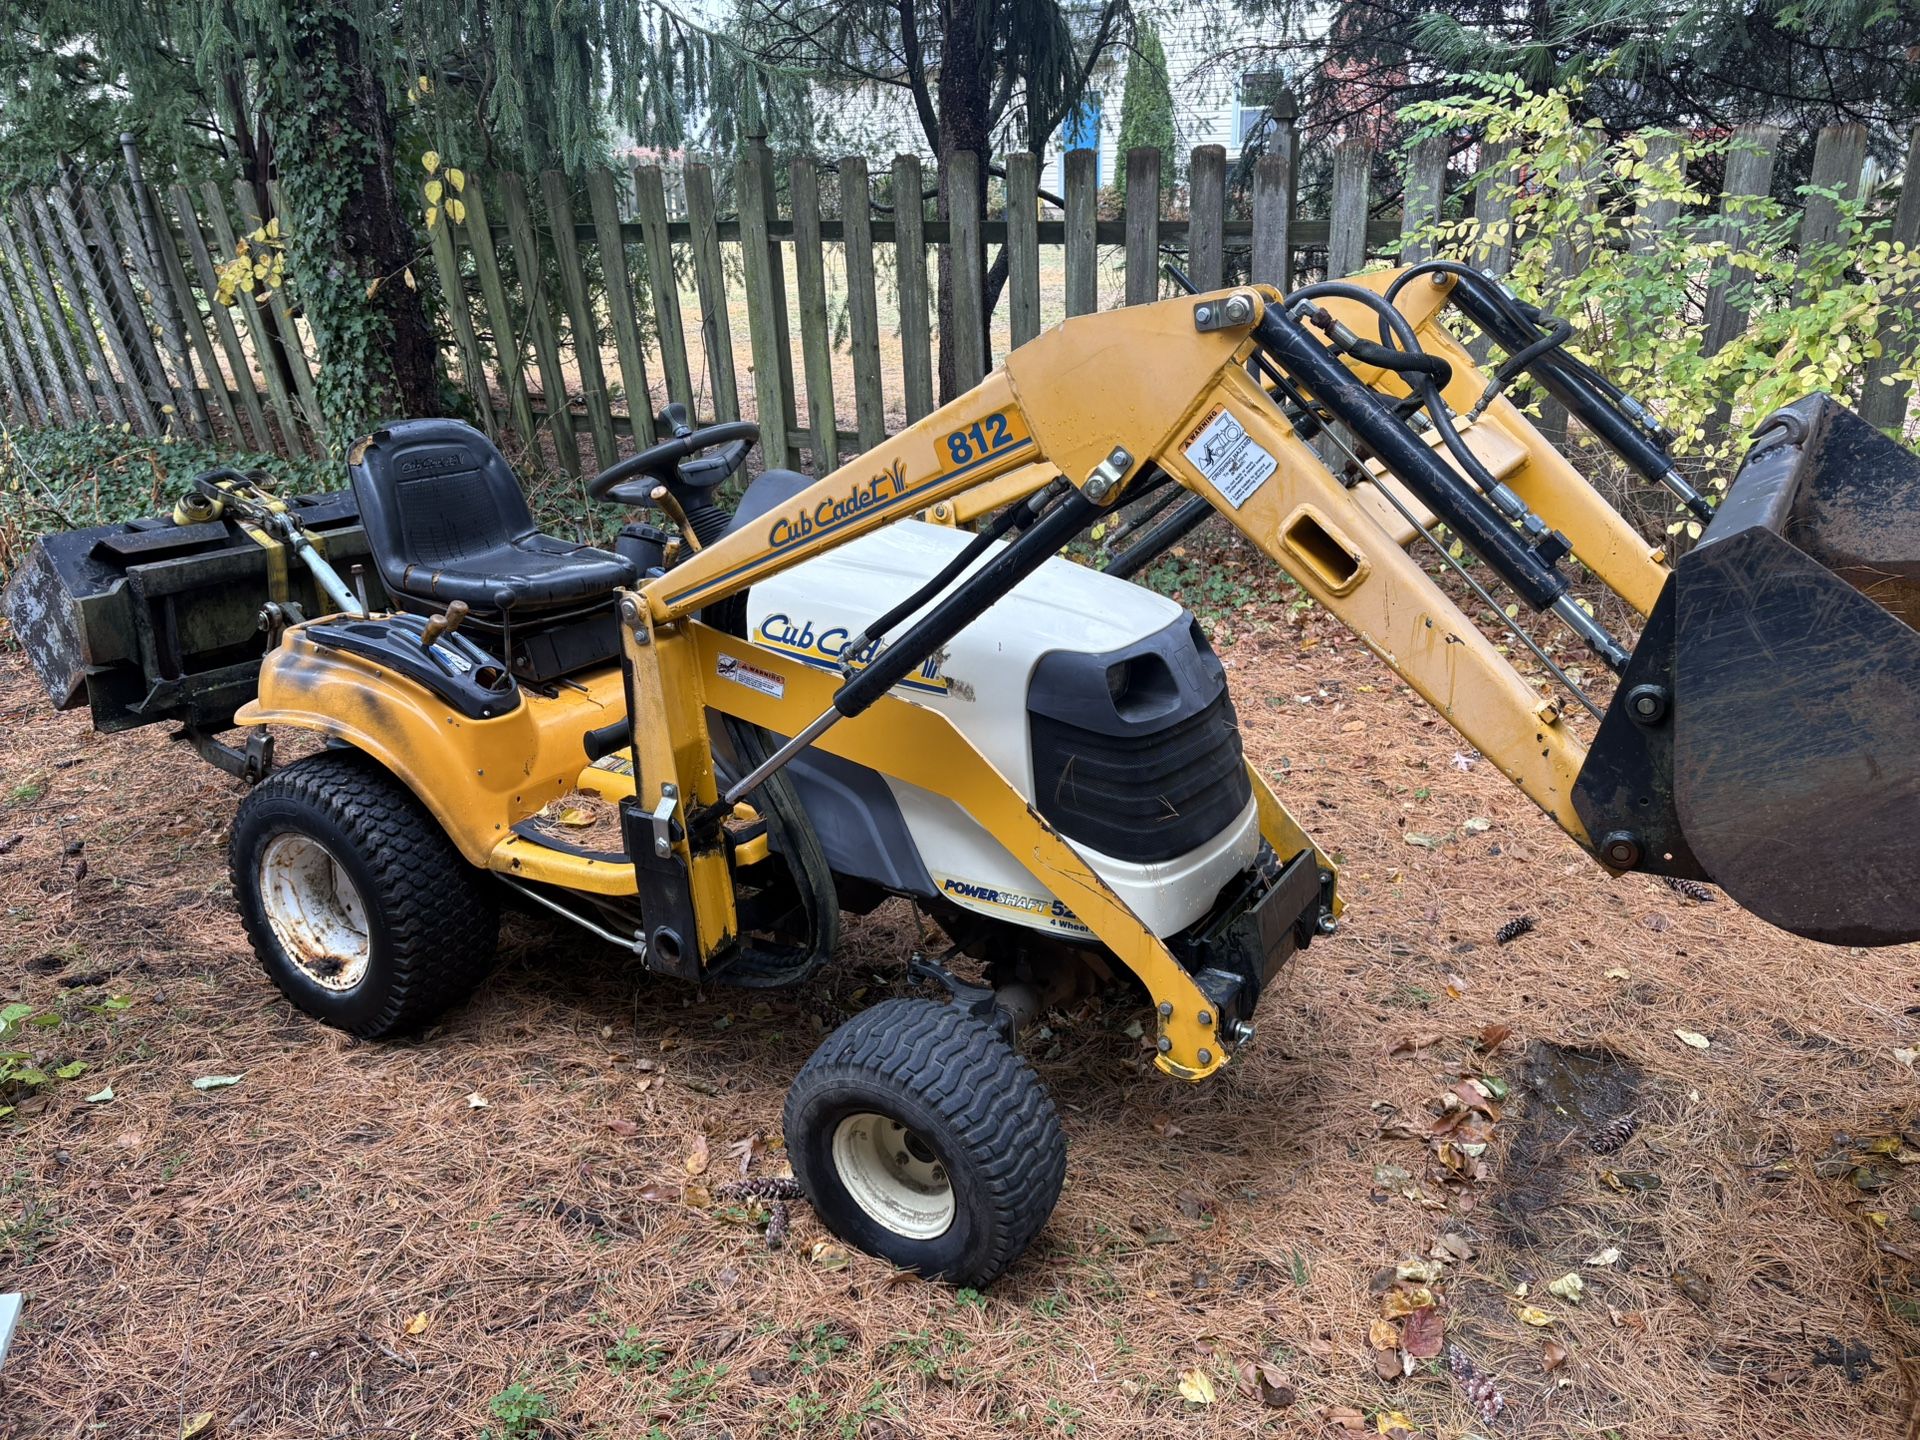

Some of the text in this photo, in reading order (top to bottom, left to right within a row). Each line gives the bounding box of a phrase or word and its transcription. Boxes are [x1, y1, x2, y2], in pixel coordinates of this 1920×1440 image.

[947, 413, 1013, 465] 812
[1189, 410, 1217, 440] WARNING
[1210, 437, 1251, 481] CRUSHING HAZARD
[770, 475, 889, 548] Cub Cadet
[761, 614, 814, 649] Cub
[749, 664, 781, 682] WARNING
[1050, 918, 1089, 932] 4 Wheel
